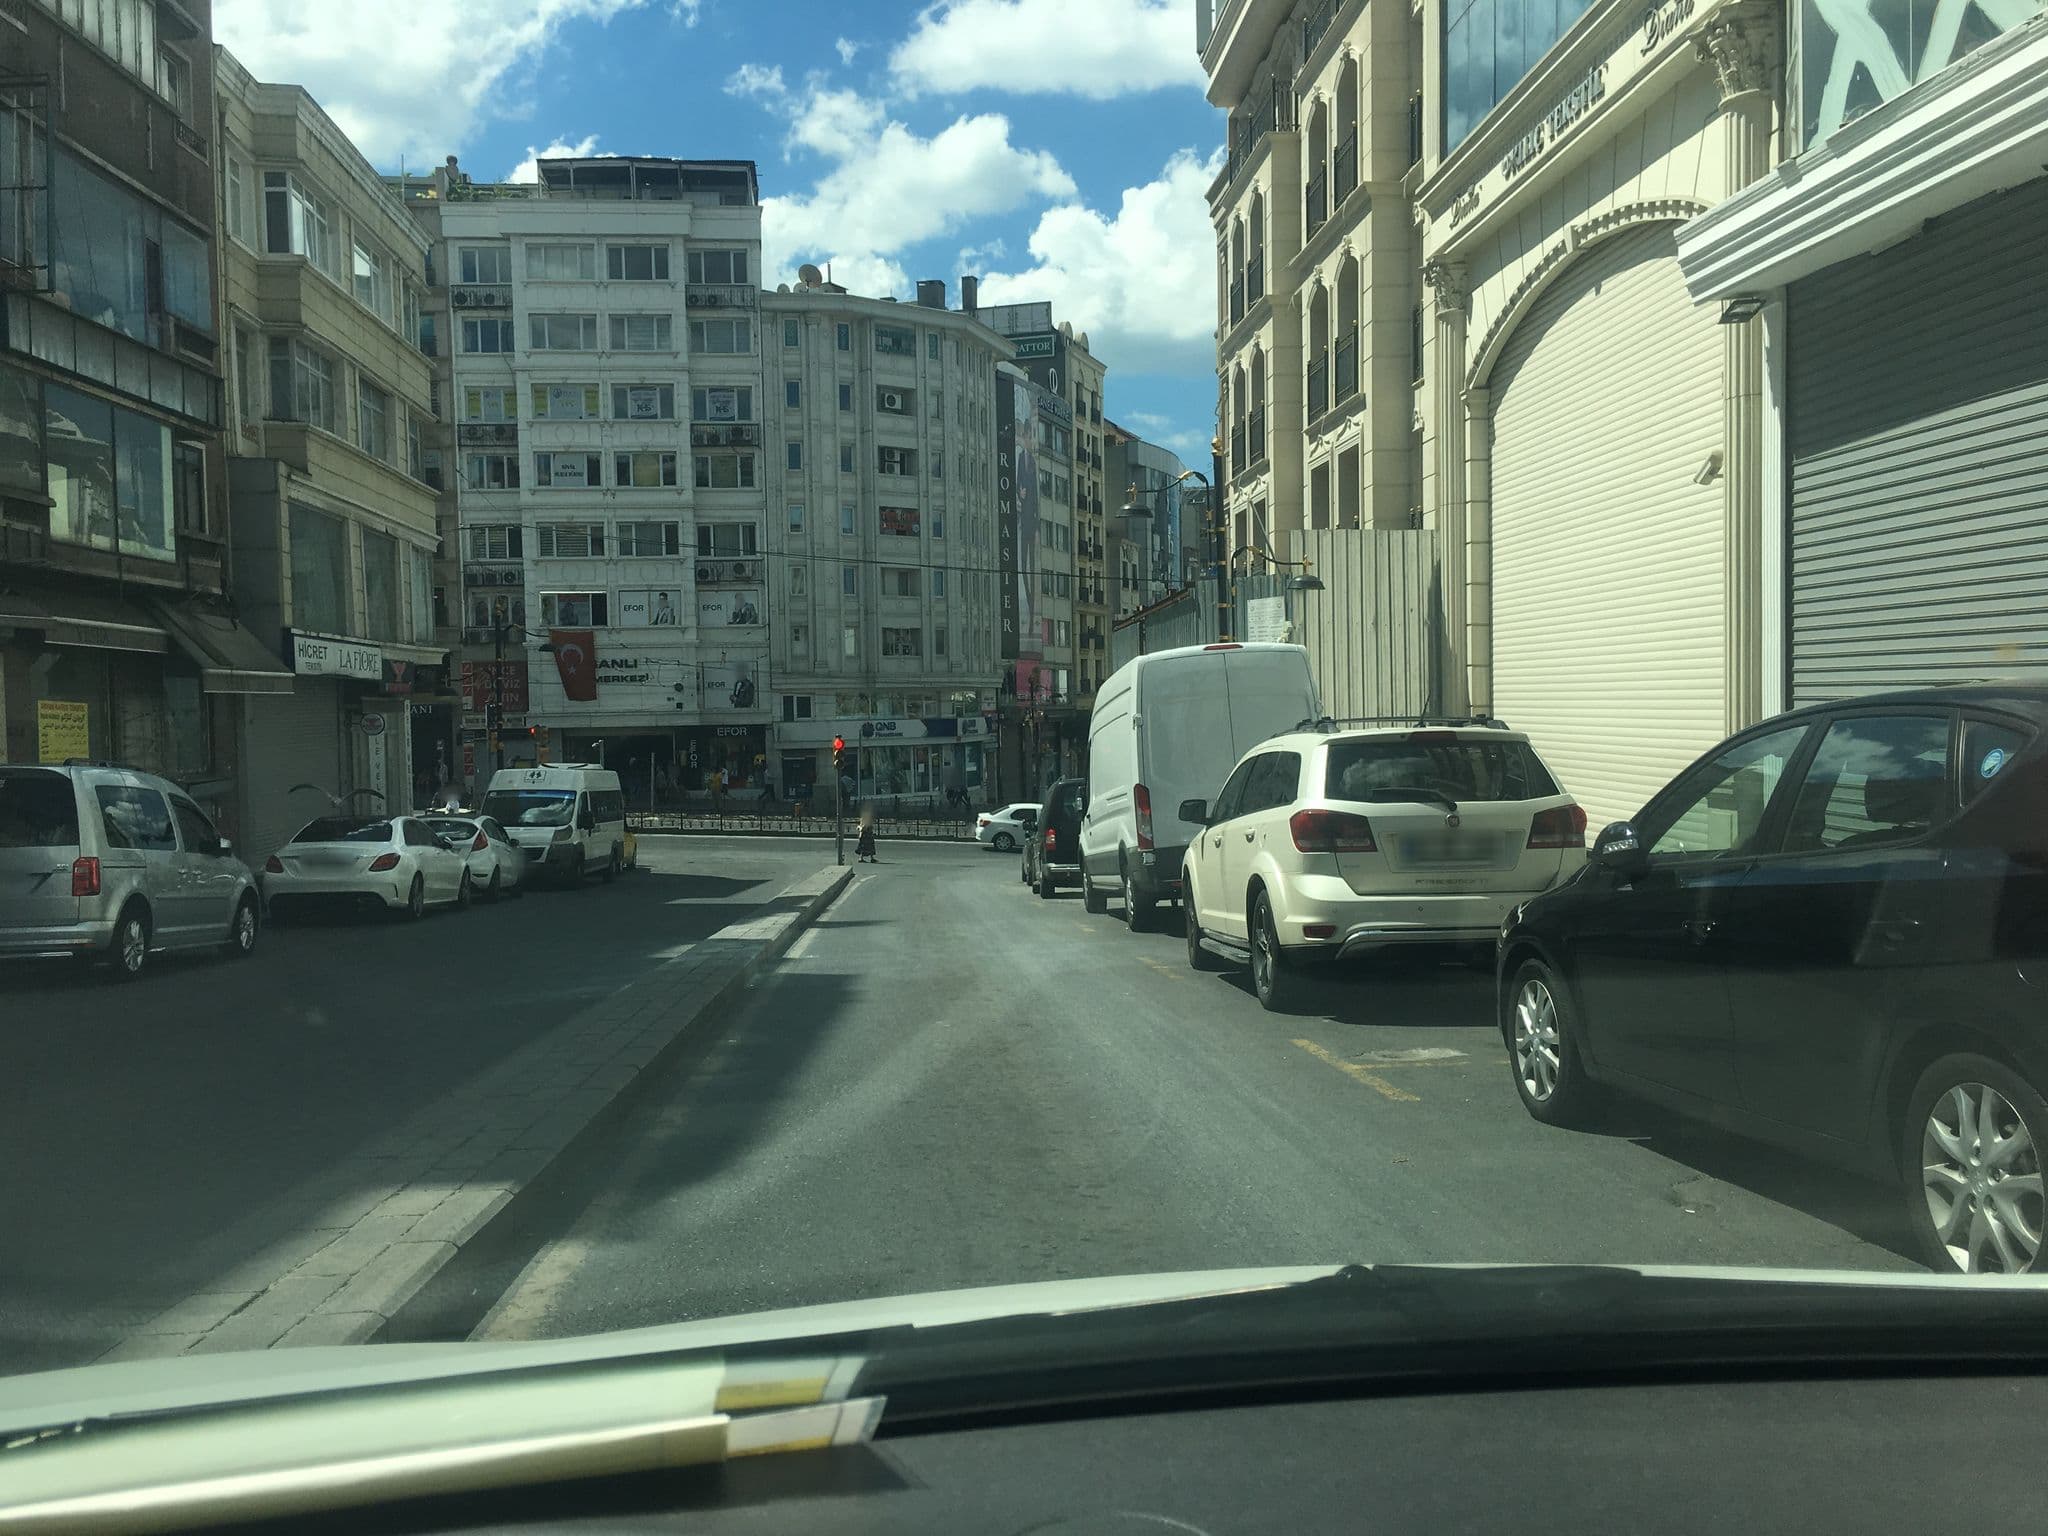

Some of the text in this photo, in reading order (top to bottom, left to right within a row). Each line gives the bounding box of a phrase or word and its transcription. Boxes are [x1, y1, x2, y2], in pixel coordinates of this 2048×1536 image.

[1018, 341, 1050, 353] ATTOR
[999, 452, 1013, 633] ROMASTER
[298, 641, 328, 660] HİCRET
[597, 658, 638, 669] ANLI
[411, 704, 432, 714] ANI
[875, 721, 897, 731] QNB
[717, 727, 747, 737] EFOR
